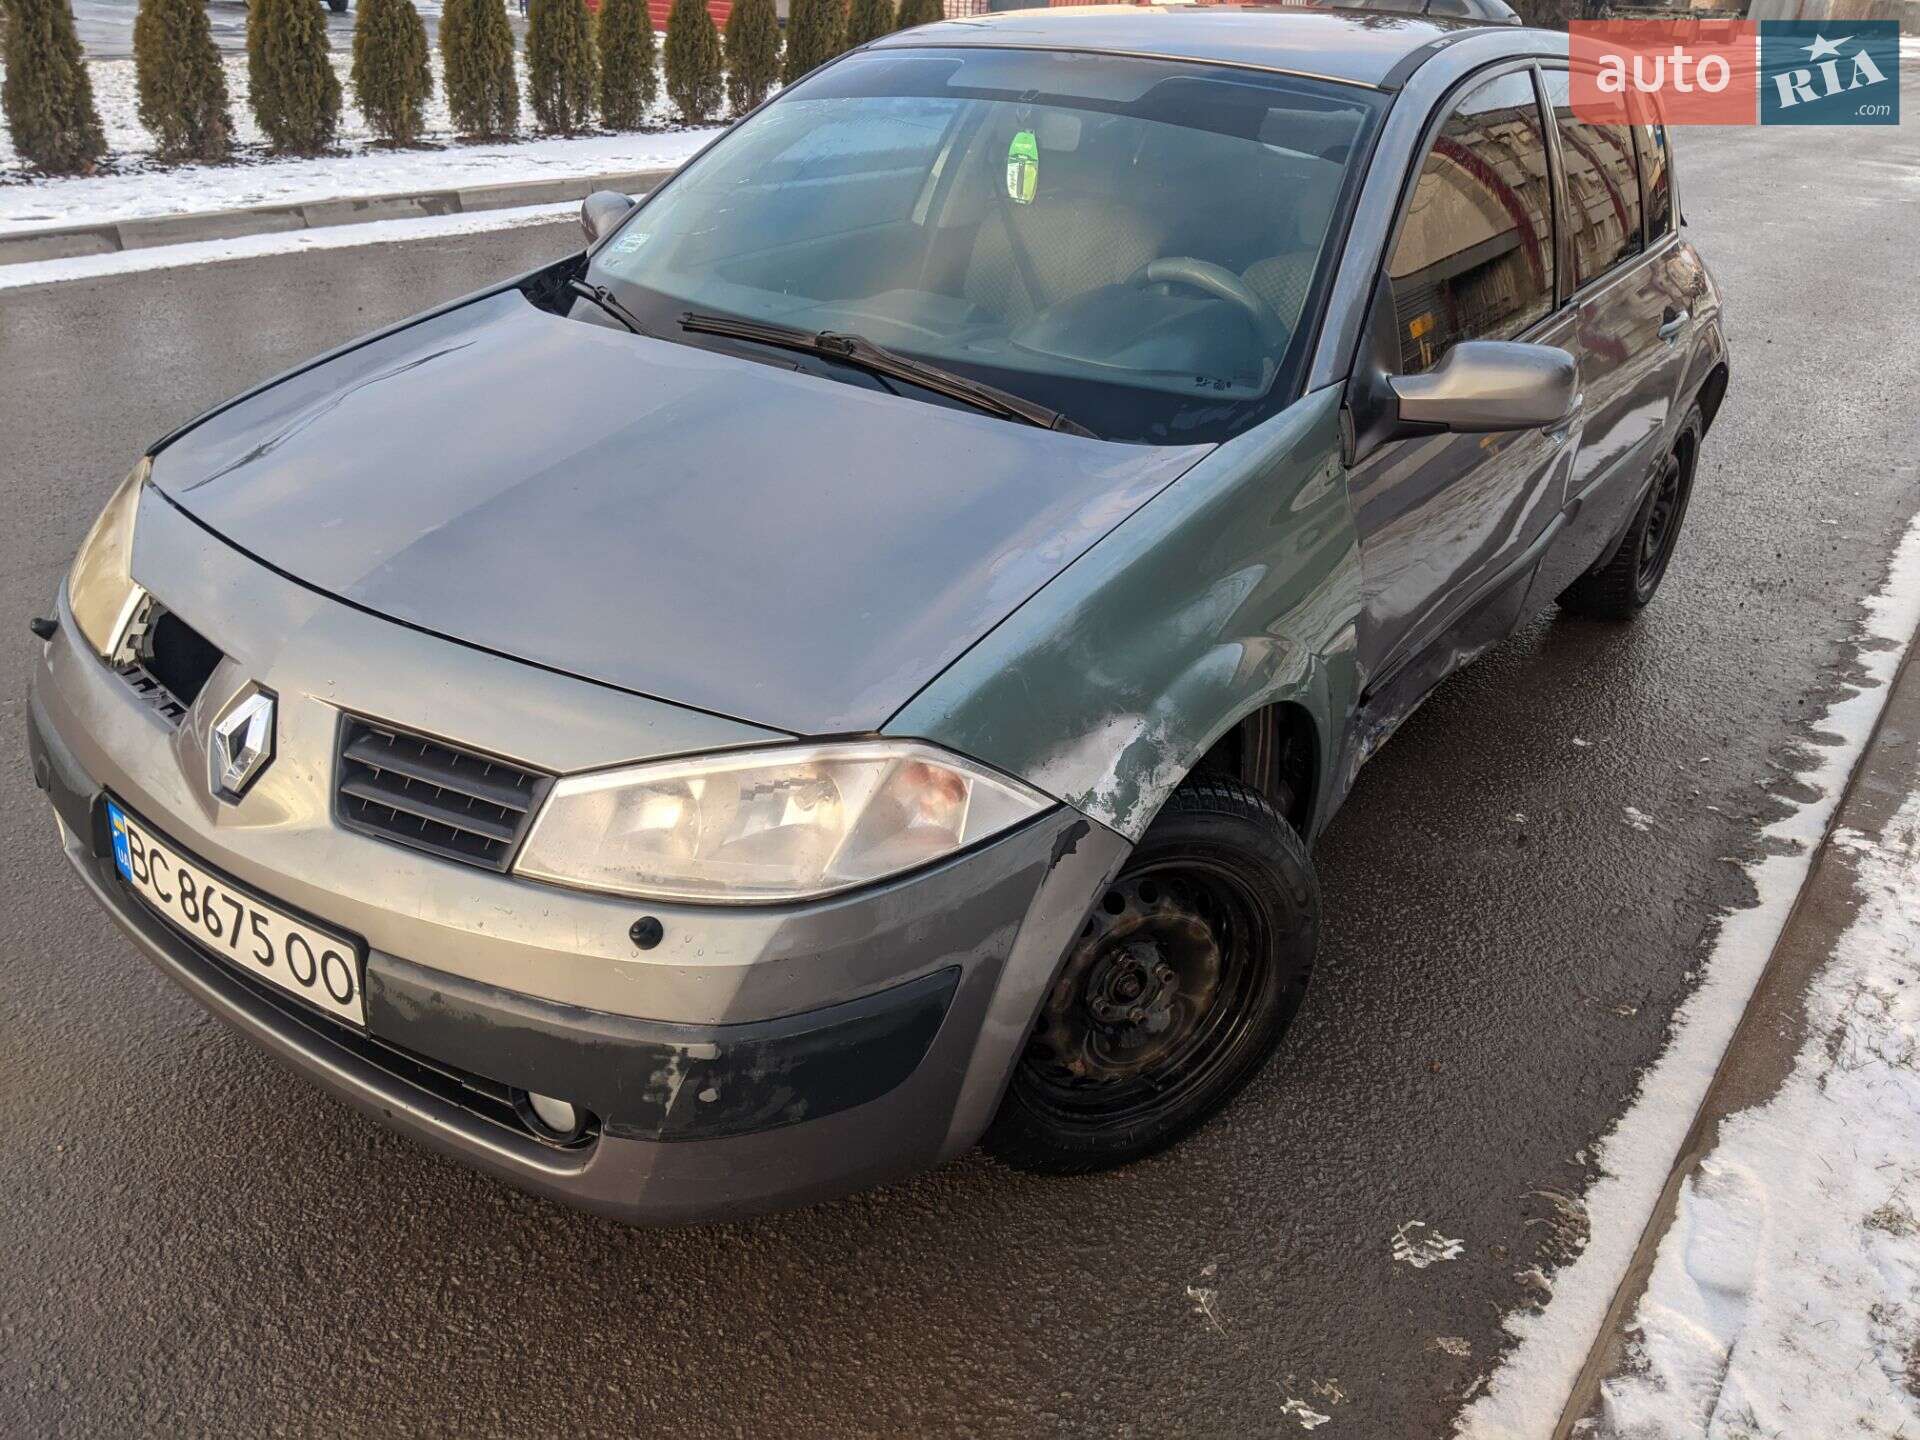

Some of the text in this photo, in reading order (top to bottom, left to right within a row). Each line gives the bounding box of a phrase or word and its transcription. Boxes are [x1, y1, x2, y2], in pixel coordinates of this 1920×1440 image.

[117, 846, 130, 867] UA
[127, 825, 172, 903] BC
[178, 868, 274, 967] 8675
